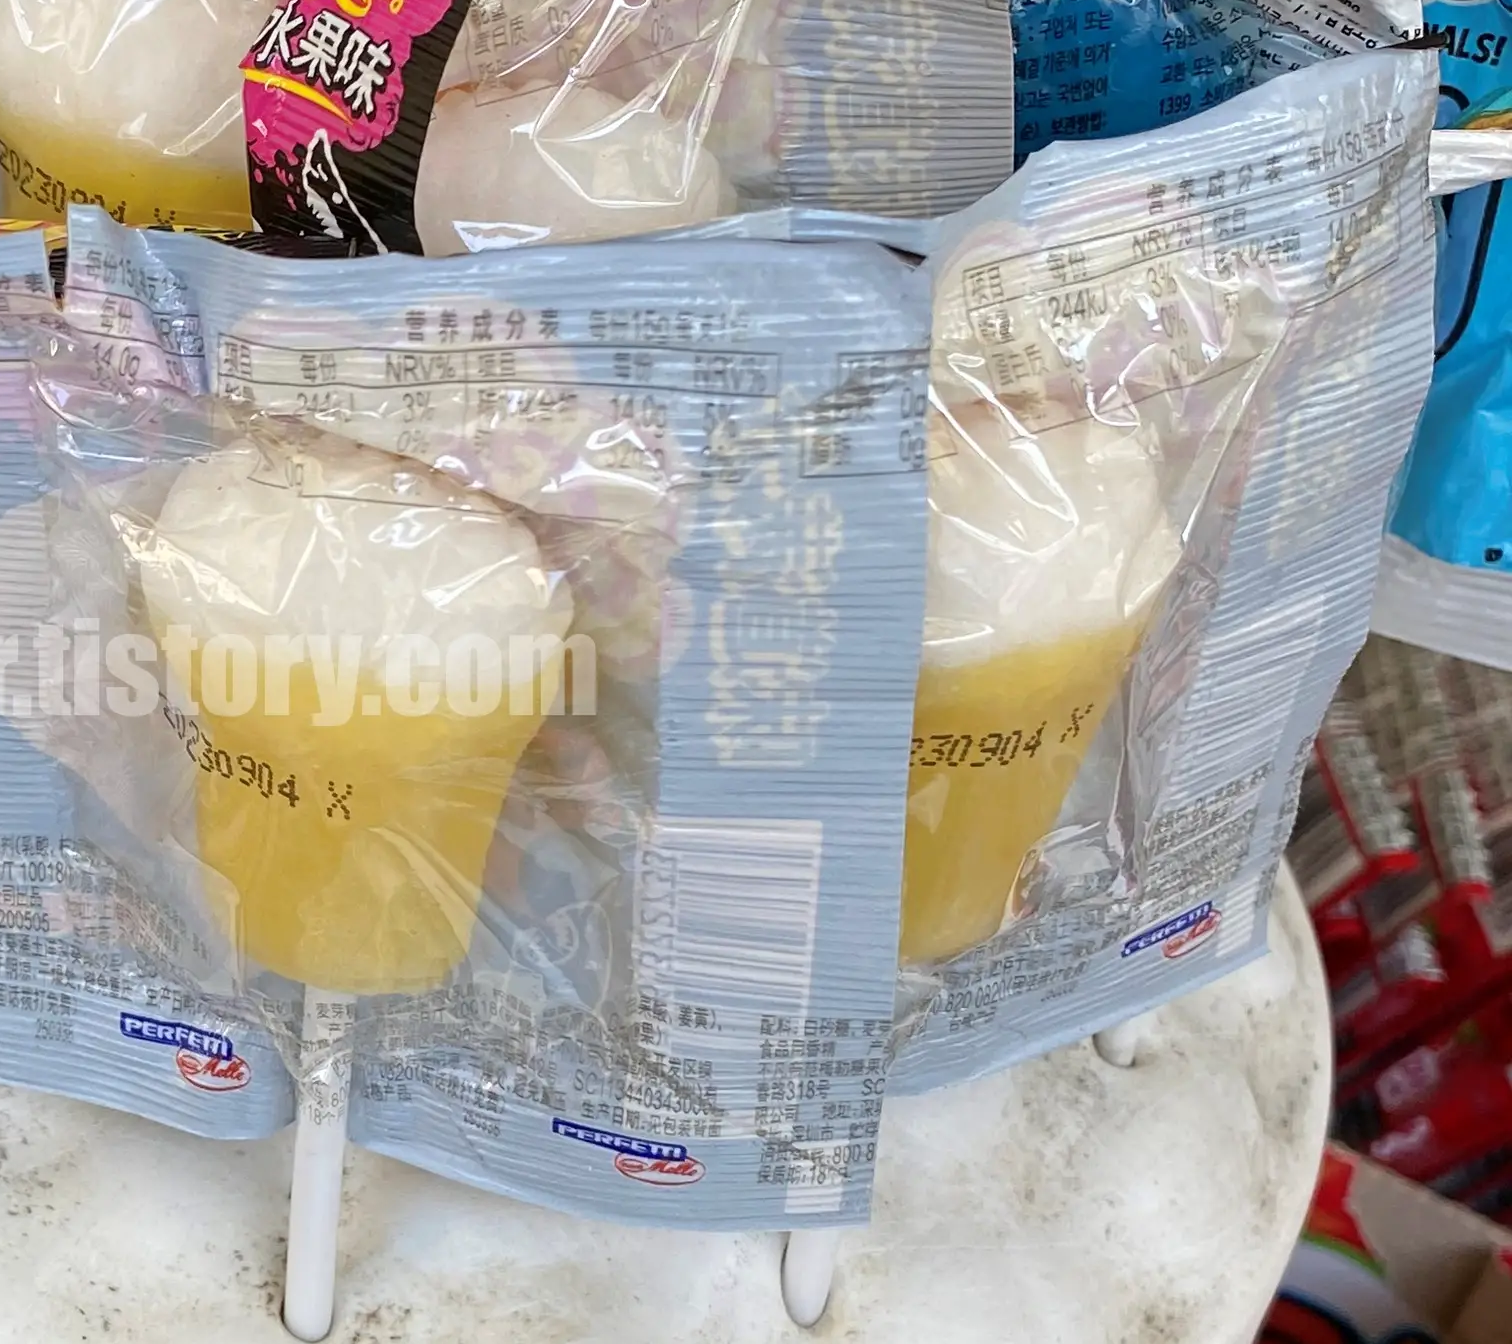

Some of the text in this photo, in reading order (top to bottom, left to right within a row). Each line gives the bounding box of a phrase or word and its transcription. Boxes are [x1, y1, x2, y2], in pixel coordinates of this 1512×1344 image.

[1038, 10, 1114, 39] 구입처 또는
[1146, 262, 1177, 298] 3%
[1048, 283, 1107, 329] 244kJ
[404, 308, 561, 342] 营养成分表
[298, 353, 337, 384] 每份
[386, 353, 457, 384] NRV%
[401, 393, 434, 424] 3%
[901, 386, 927, 420] 0g
[898, 428, 928, 469] 0g
[123, 1015, 231, 1059] PERFETTI
[556, 1121, 684, 1161] PERFETTI
